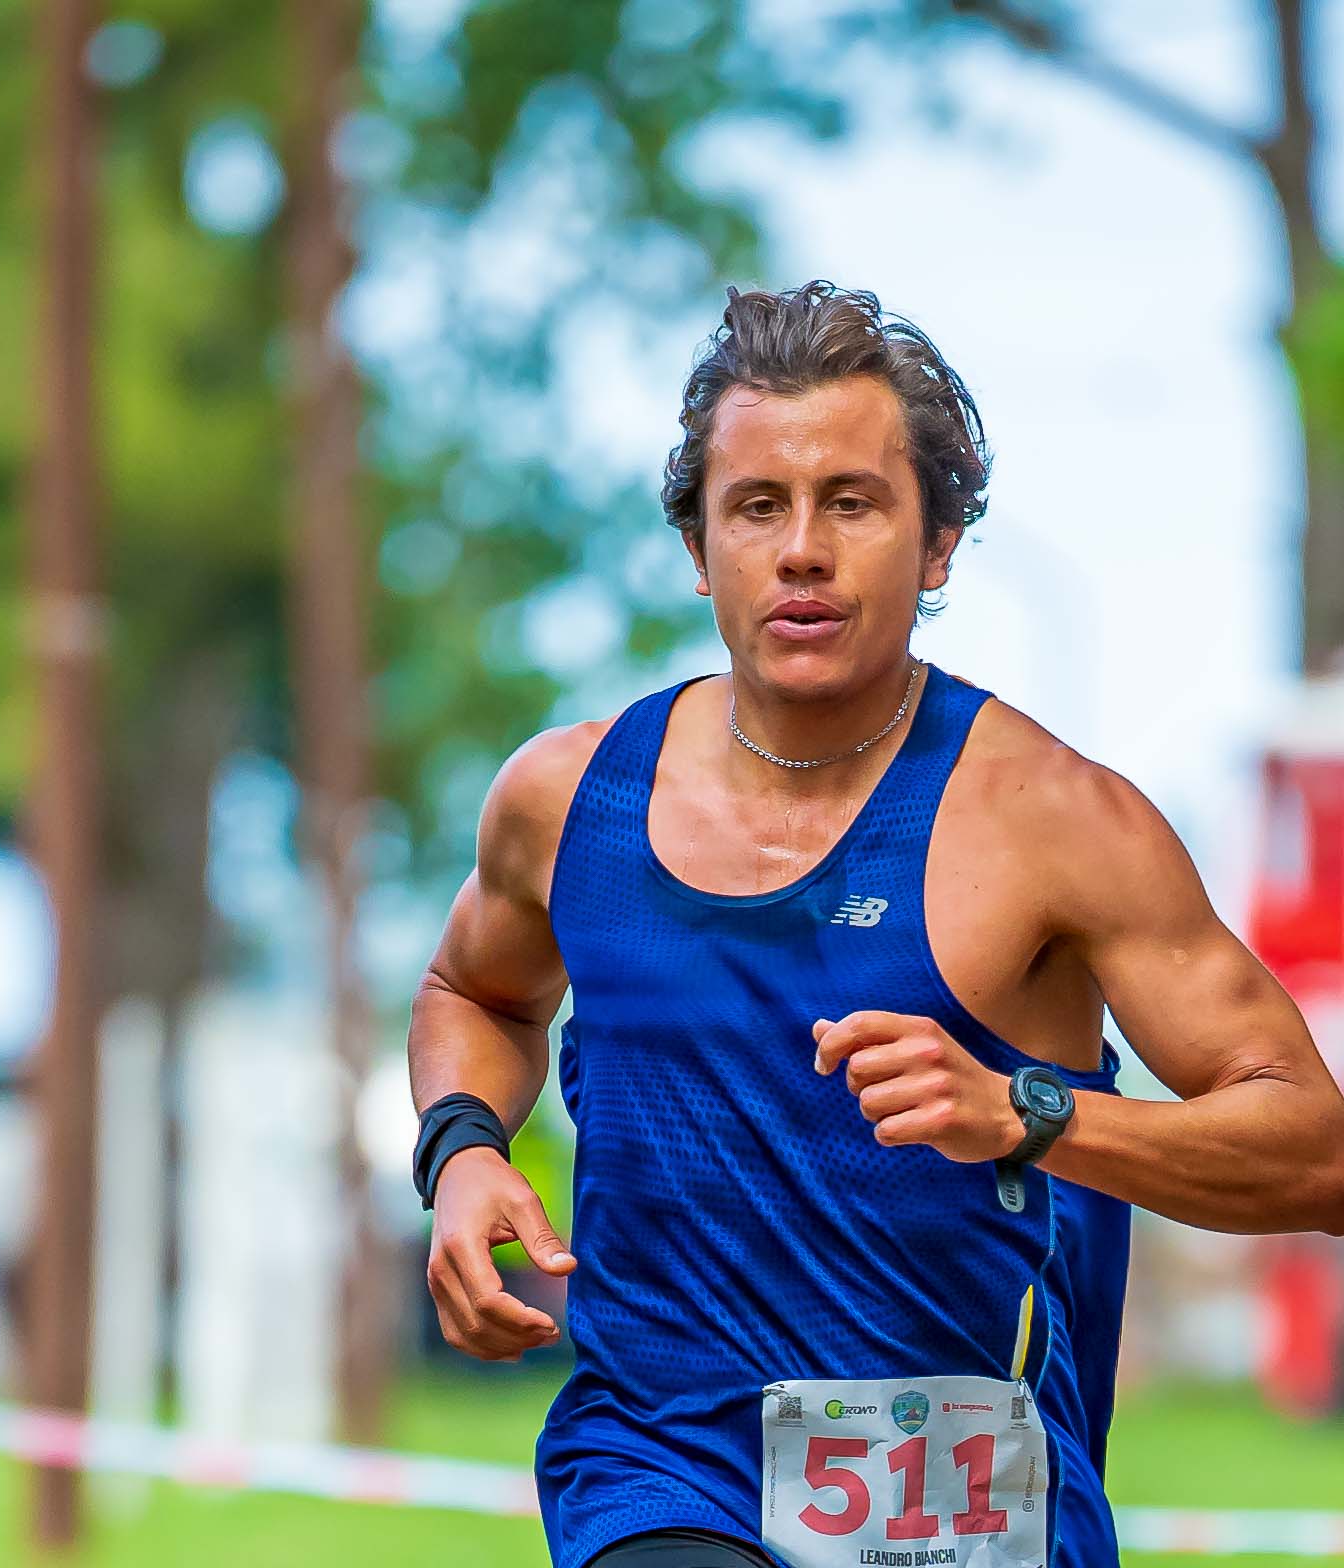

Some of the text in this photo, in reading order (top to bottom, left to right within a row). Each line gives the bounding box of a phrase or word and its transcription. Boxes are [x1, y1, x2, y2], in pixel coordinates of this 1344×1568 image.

[798, 1433, 1009, 1540] 511
[860, 1548, 957, 1567] LEANDRO BIANCHI
